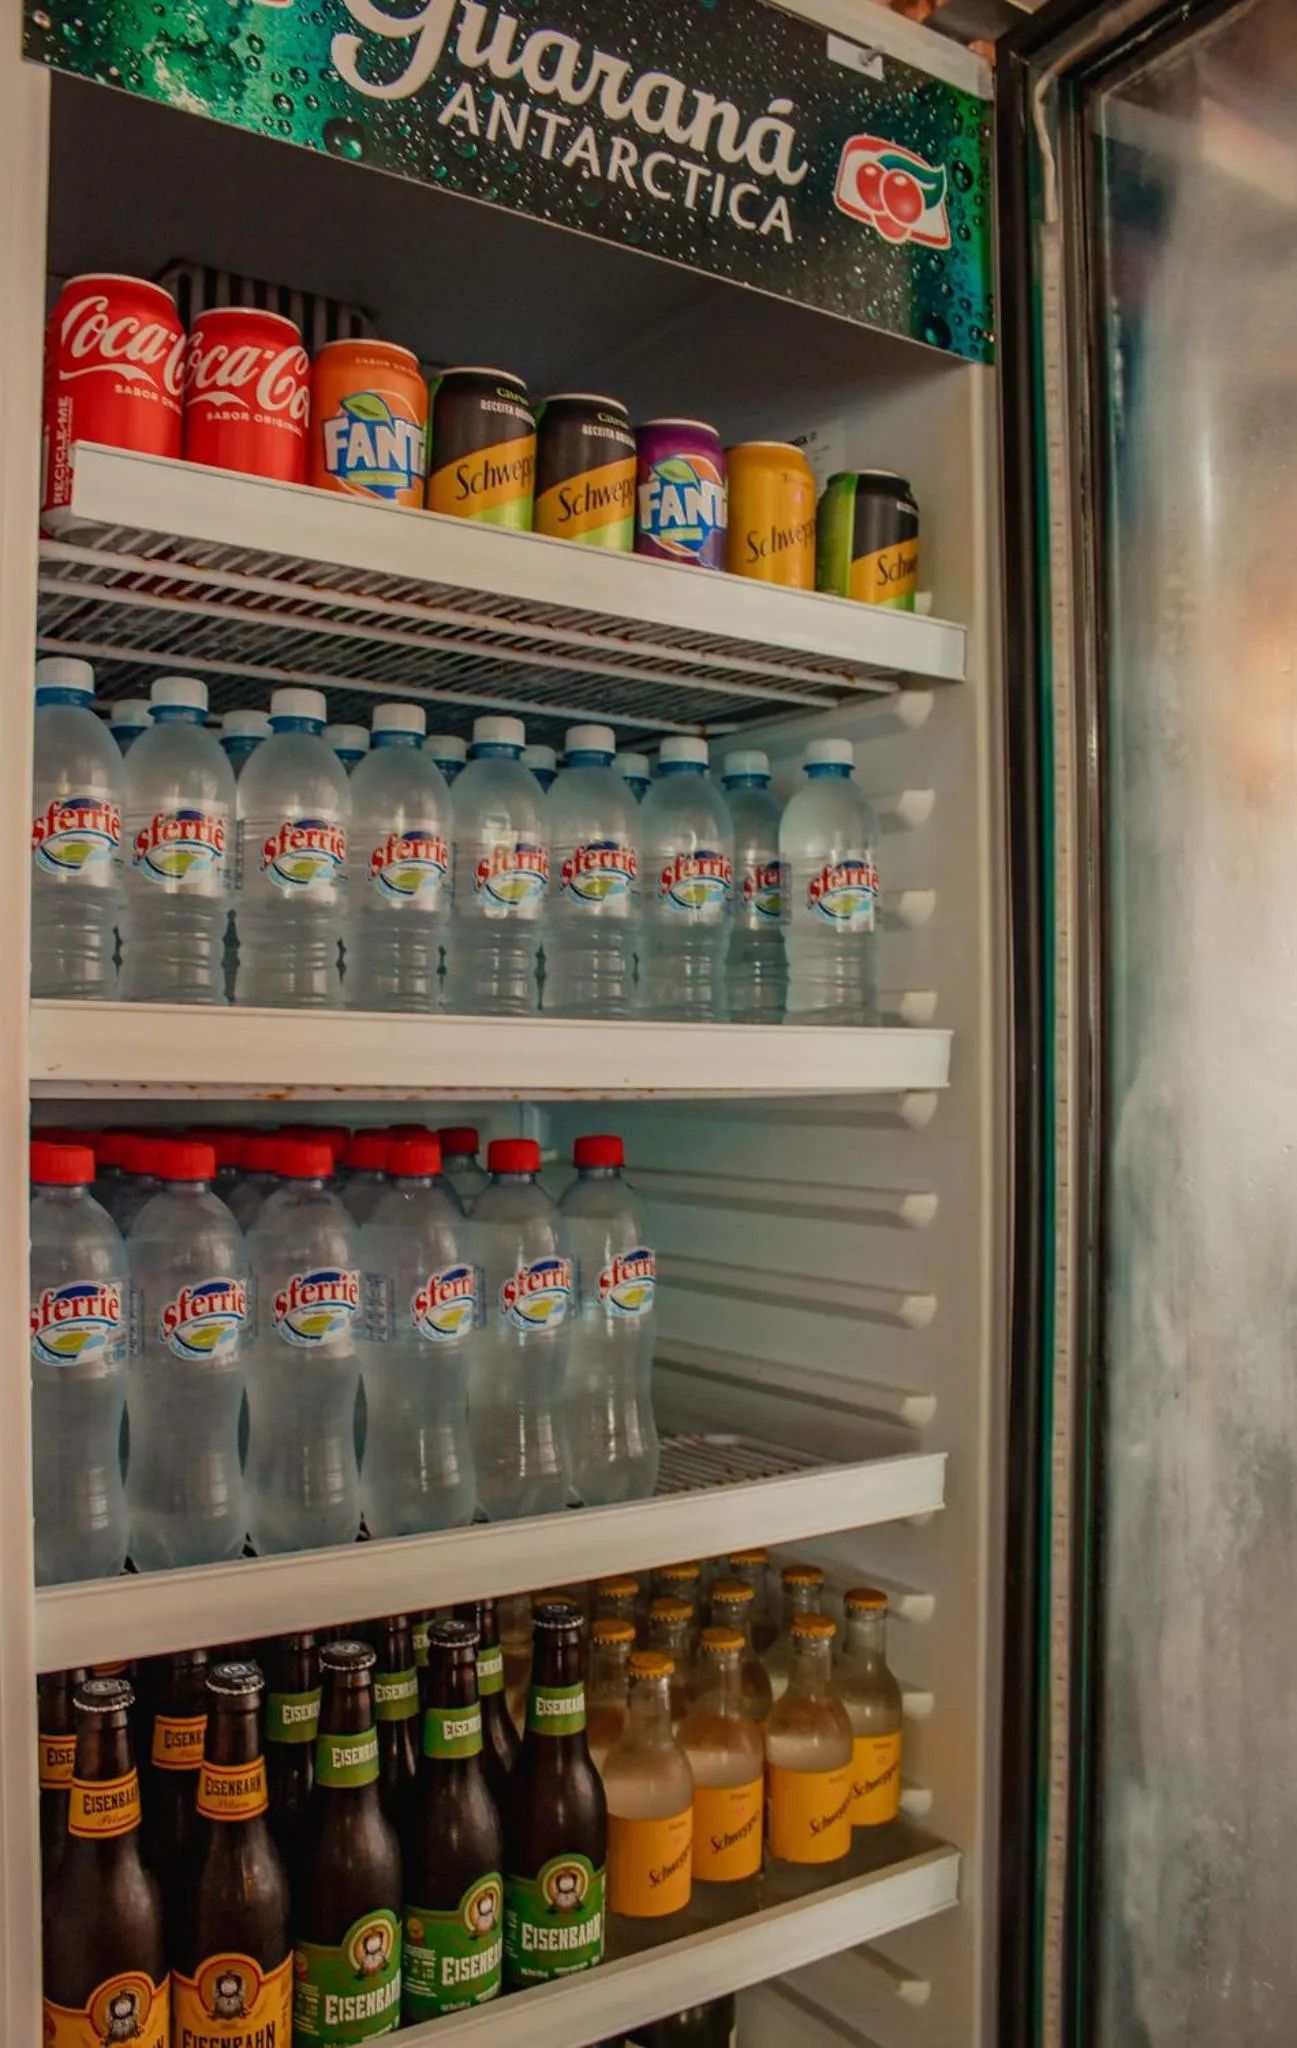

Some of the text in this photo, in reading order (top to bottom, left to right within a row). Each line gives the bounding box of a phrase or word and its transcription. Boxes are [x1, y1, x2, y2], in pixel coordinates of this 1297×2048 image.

[438, 82, 794, 243] ANTARCTICA
[114, 383, 159, 404] SABOR
[206, 410, 250, 422] SABOR
[324, 415, 426, 477] FANT
[638, 479, 728, 530] FANT
[46, 1746, 75, 1767] EISE
[205, 1773, 262, 1797] EISENBAHN
[521, 1911, 602, 1952] EISENBAHN
